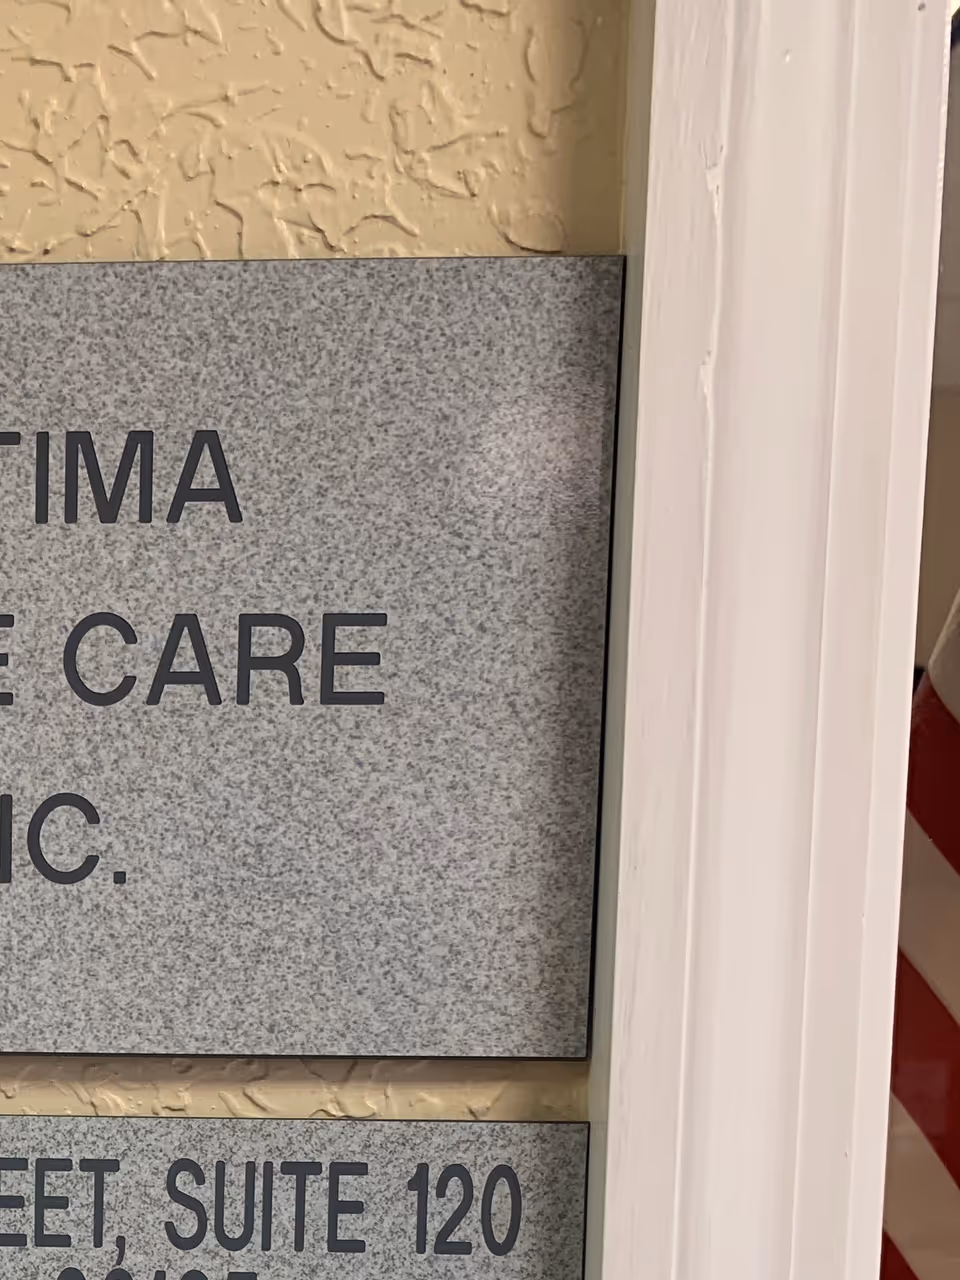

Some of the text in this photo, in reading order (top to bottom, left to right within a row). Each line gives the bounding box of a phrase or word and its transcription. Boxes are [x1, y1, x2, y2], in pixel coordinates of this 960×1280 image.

[63, 612, 388, 707] CARE
[164, 1158, 369, 1254] SUITE
[407, 1162, 523, 1257] 120
